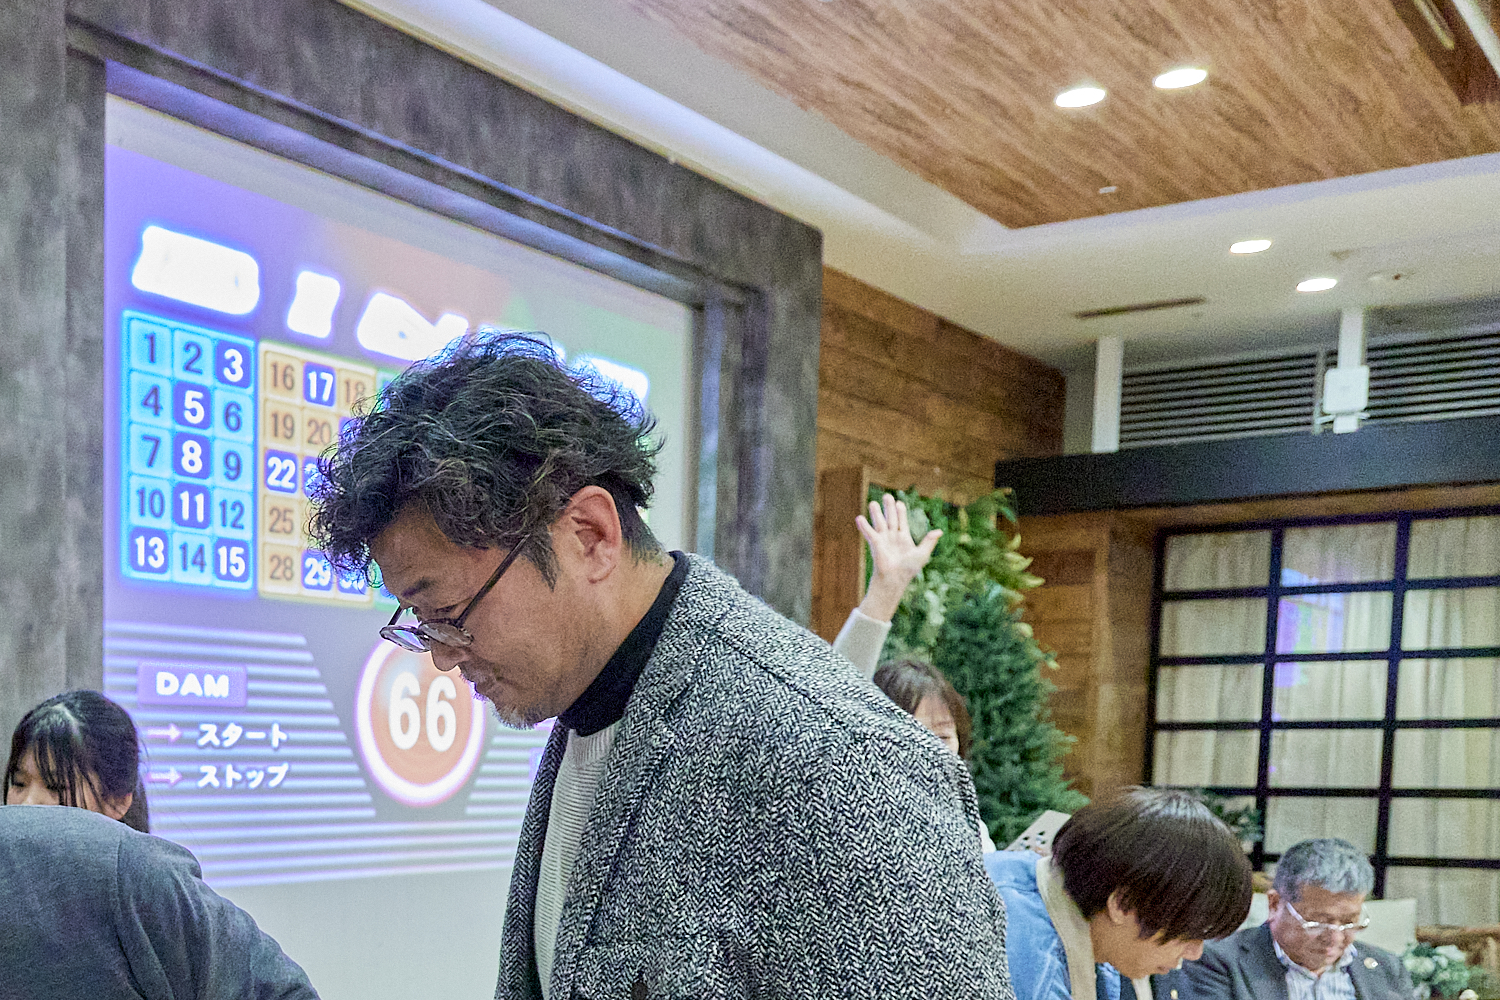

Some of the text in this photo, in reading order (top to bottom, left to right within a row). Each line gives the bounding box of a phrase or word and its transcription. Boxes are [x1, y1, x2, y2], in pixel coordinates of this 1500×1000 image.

[145, 333, 244, 383] 1 2 3
[271, 361, 295, 391] 16
[307, 371, 334, 402] 17
[142, 385, 242, 432] 4 5 6
[271, 412, 332, 446] 19 20
[142, 434, 242, 481] 7 8 9
[267, 456, 296, 489] 22
[137, 487, 245, 530] 10 11 12
[269, 506, 294, 534] 25
[135, 535, 246, 577] 13 14 15
[269, 555, 294, 582] 28
[304, 557, 331, 587] 29
[155, 671, 230, 698] DAM
[388, 672, 457, 752] 66
[196, 722, 289, 749] スタート
[197, 762, 290, 789] ストップ
